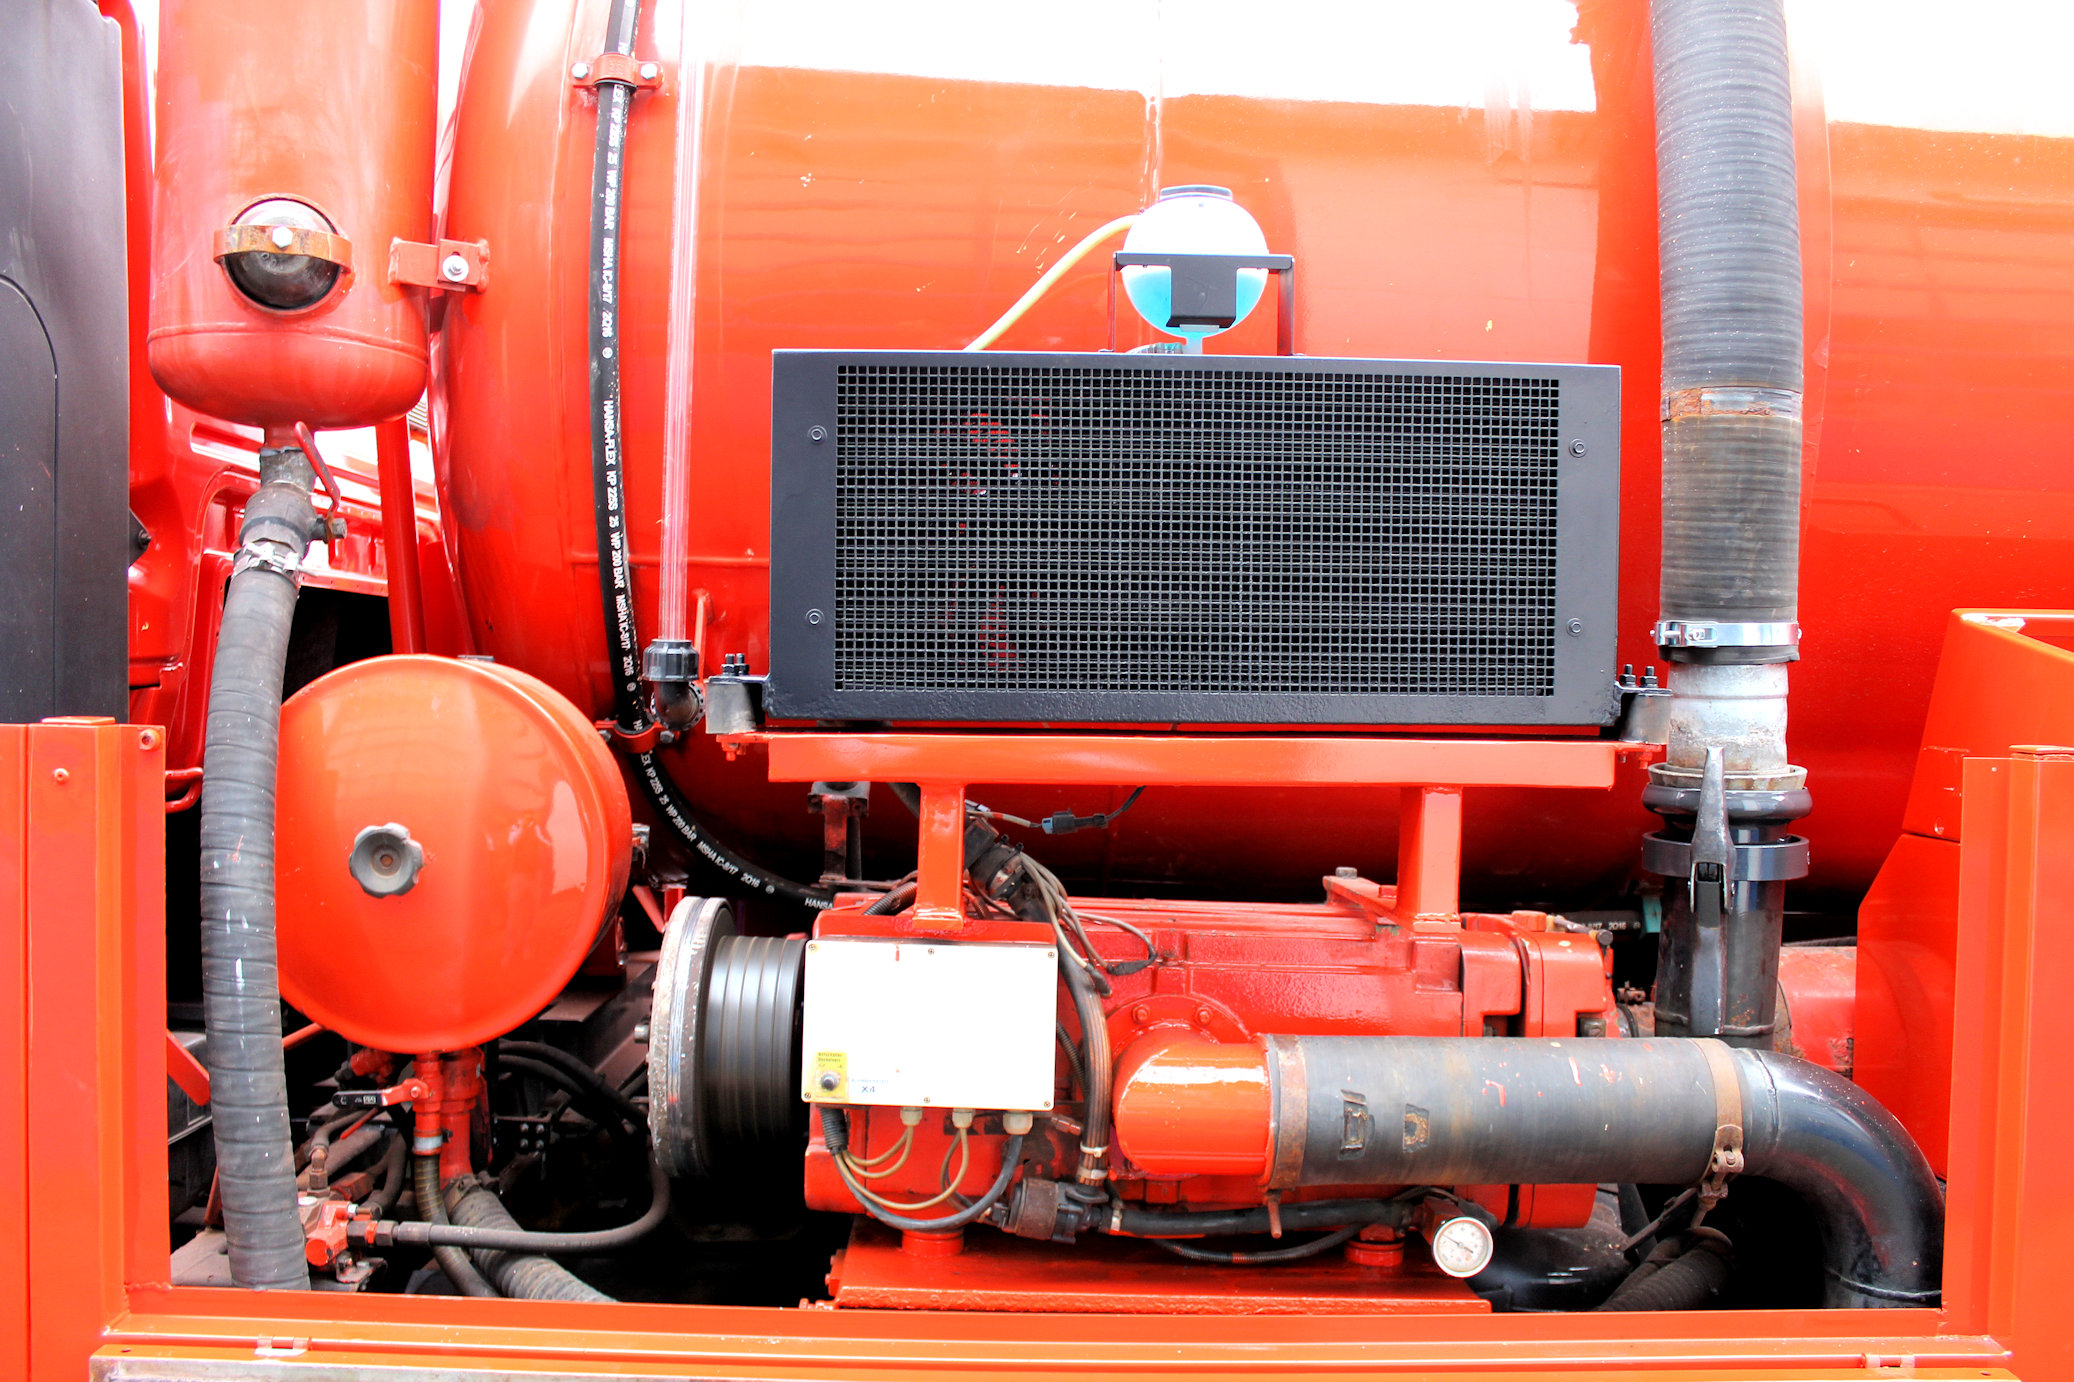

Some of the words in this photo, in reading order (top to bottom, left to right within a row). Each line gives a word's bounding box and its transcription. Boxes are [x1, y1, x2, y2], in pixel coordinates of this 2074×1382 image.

[607, 151, 618, 165] 25
[606, 169, 618, 188] WP
[604, 187, 617, 207] 200
[603, 205, 616, 230] BAR
[602, 237, 614, 269] MSHA
[603, 399, 617, 466] HANSA-FLEX
[606, 470, 618, 487] KP
[607, 485, 619, 511] 225S
[609, 516, 620, 529] 25
[610, 531, 621, 550] WP
[611, 548, 623, 568] 200
[613, 567, 625, 590] BAR
[615, 593, 628, 623] MSHA
[645, 766, 657, 778] KP
[658, 794, 670, 805] 25
[665, 804, 678, 817] WP
[672, 815, 686, 829] 200
[681, 824, 697, 842] BAR
[696, 840, 717, 861] MSHA
[861, 1085, 876, 1094] X4
